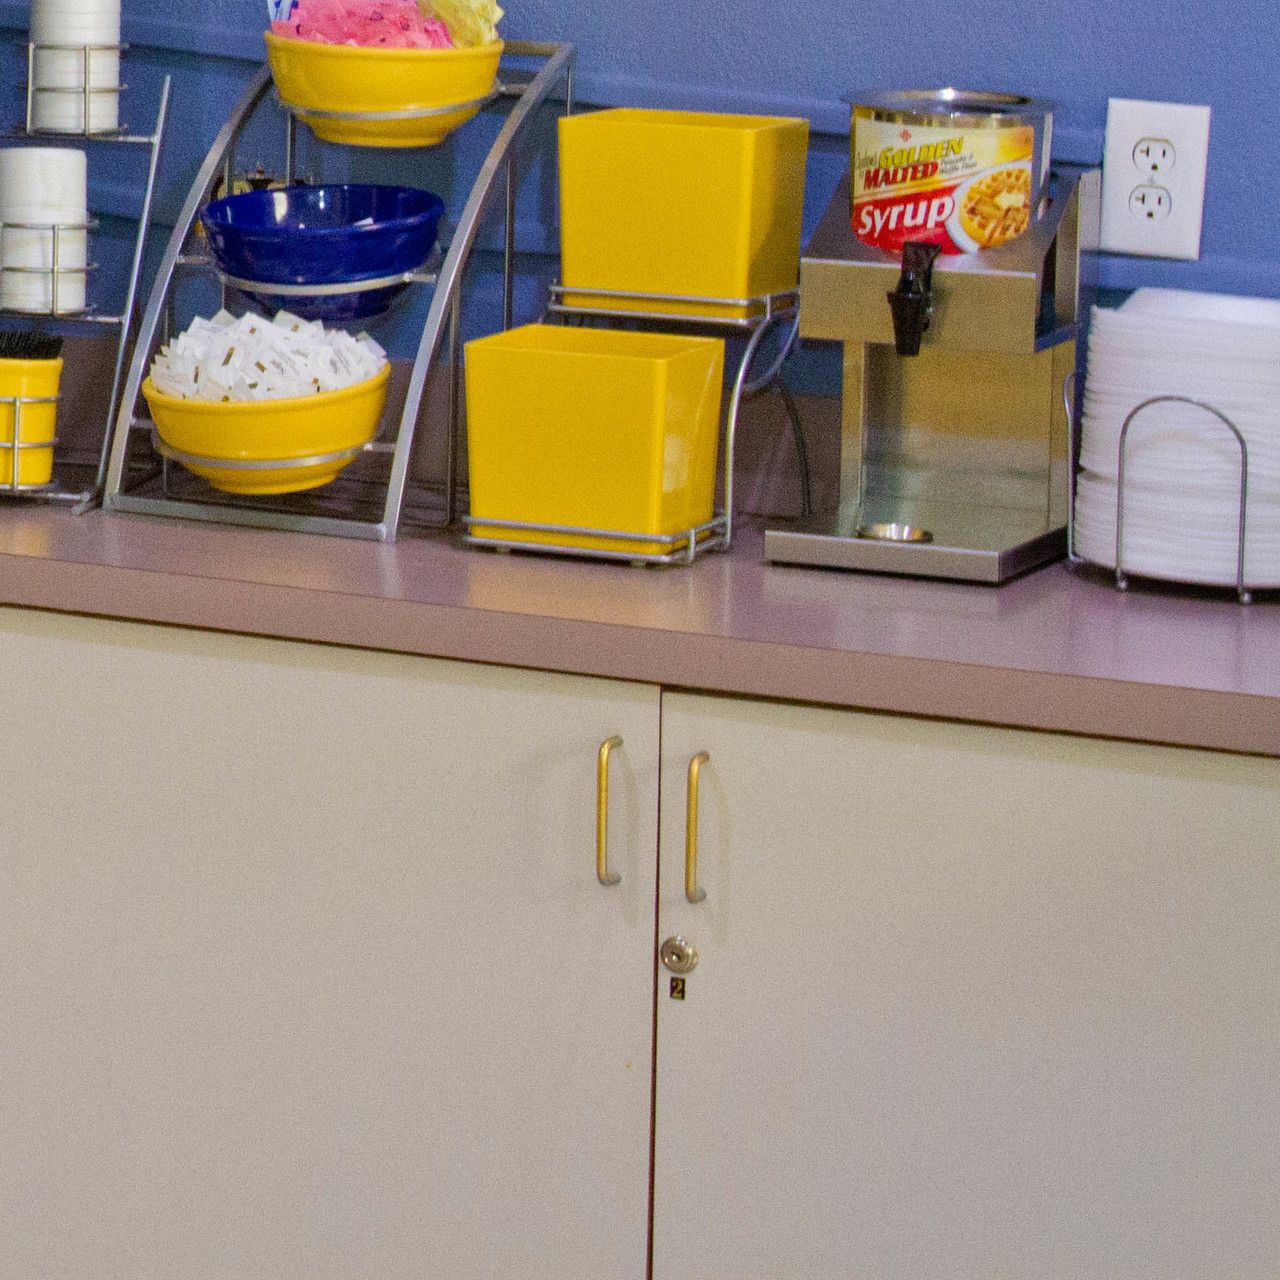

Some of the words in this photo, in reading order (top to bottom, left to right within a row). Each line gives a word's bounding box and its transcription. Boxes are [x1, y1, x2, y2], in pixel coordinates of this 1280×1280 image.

[879, 136, 964, 168] GOLDEN
[864, 160, 939, 190] MALTED
[857, 195, 954, 239] Syrup
